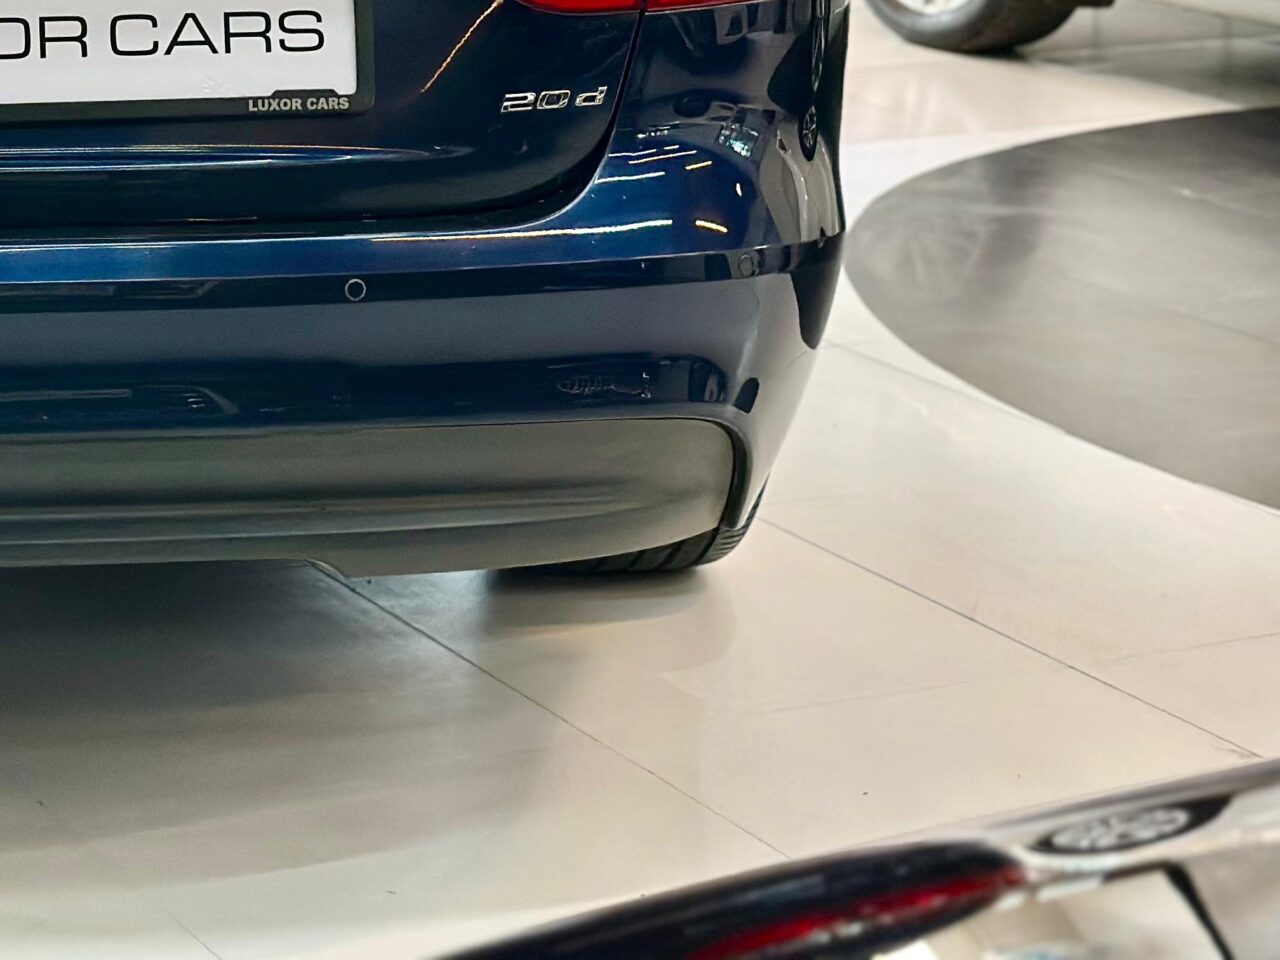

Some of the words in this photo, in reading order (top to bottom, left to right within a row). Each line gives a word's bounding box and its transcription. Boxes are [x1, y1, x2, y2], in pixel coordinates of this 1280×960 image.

[109, 9, 325, 56] CARS
[248, 97, 303, 112] LUXOR
[306, 96, 350, 111] CARS
